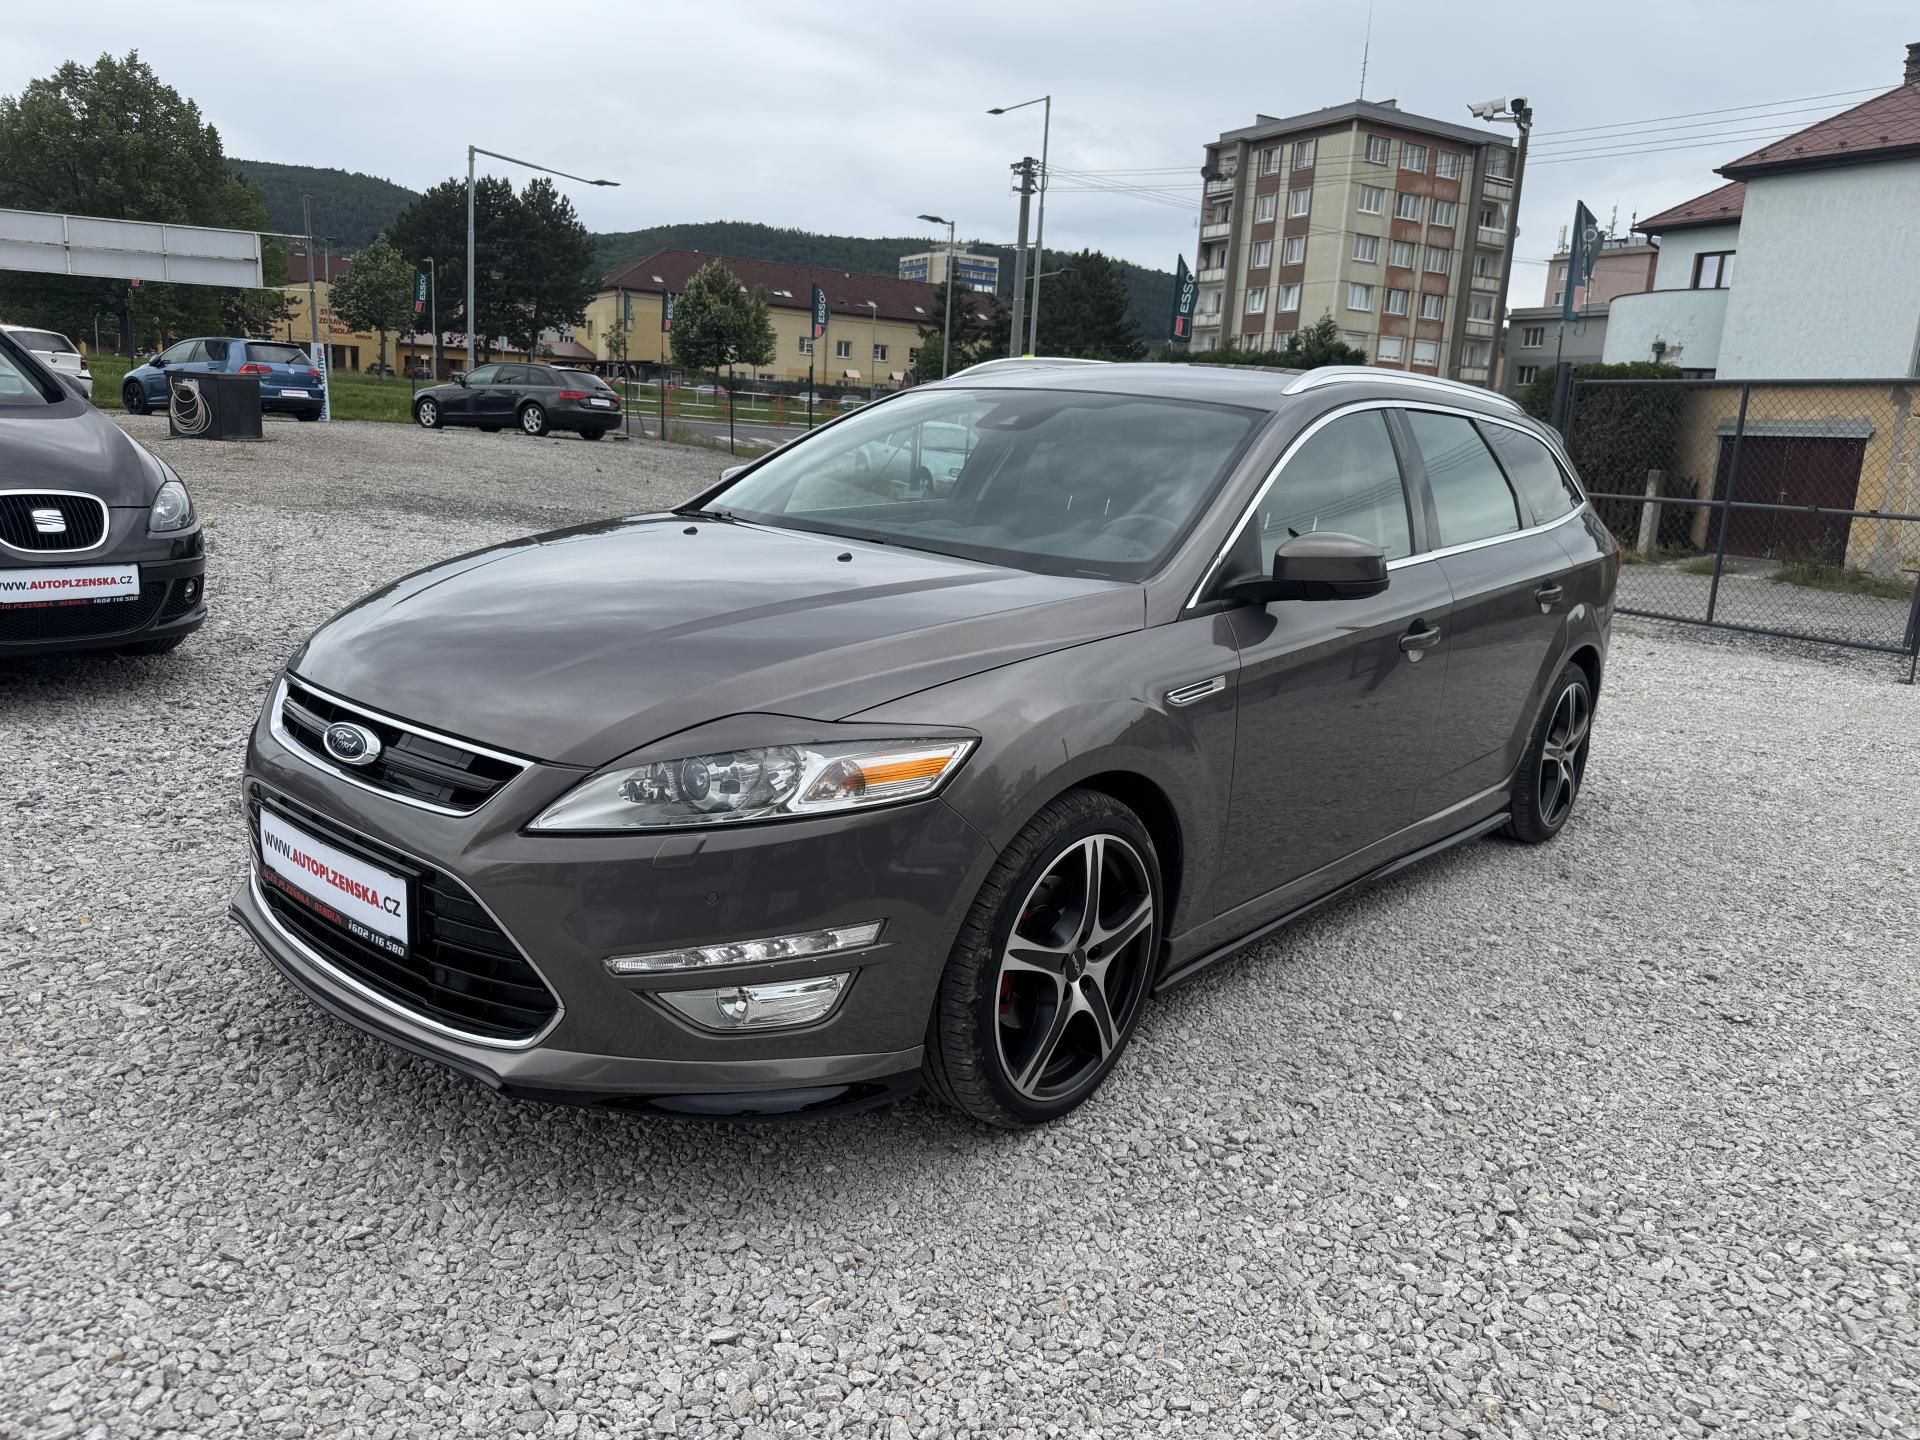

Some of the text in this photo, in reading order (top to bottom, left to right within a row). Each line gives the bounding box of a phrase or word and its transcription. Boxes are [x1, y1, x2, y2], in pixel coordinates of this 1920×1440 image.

[331, 730, 357, 752] Ford
[264, 829, 401, 918] WWW.AUTOPLZENSKA.CZ
[371, 933, 385, 947] 116
[386, 940, 405, 957] 580
